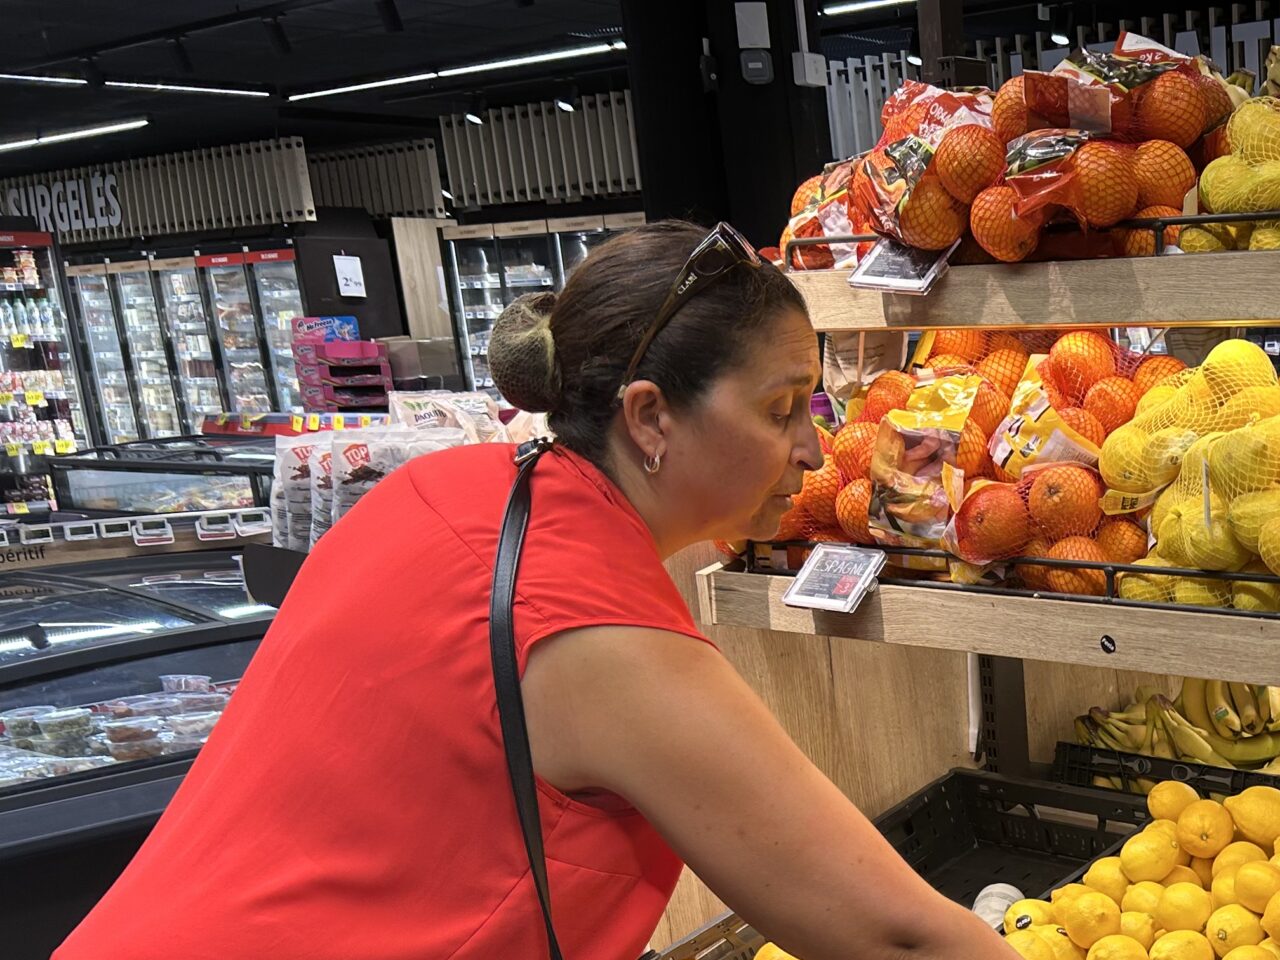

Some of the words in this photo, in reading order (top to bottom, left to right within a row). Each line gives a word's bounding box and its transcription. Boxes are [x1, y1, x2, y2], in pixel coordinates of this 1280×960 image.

[9, 171, 123, 233] SURGELÉS
[346, 448, 369, 464] TOP
[813, 560, 867, 575] ESPAGNE
